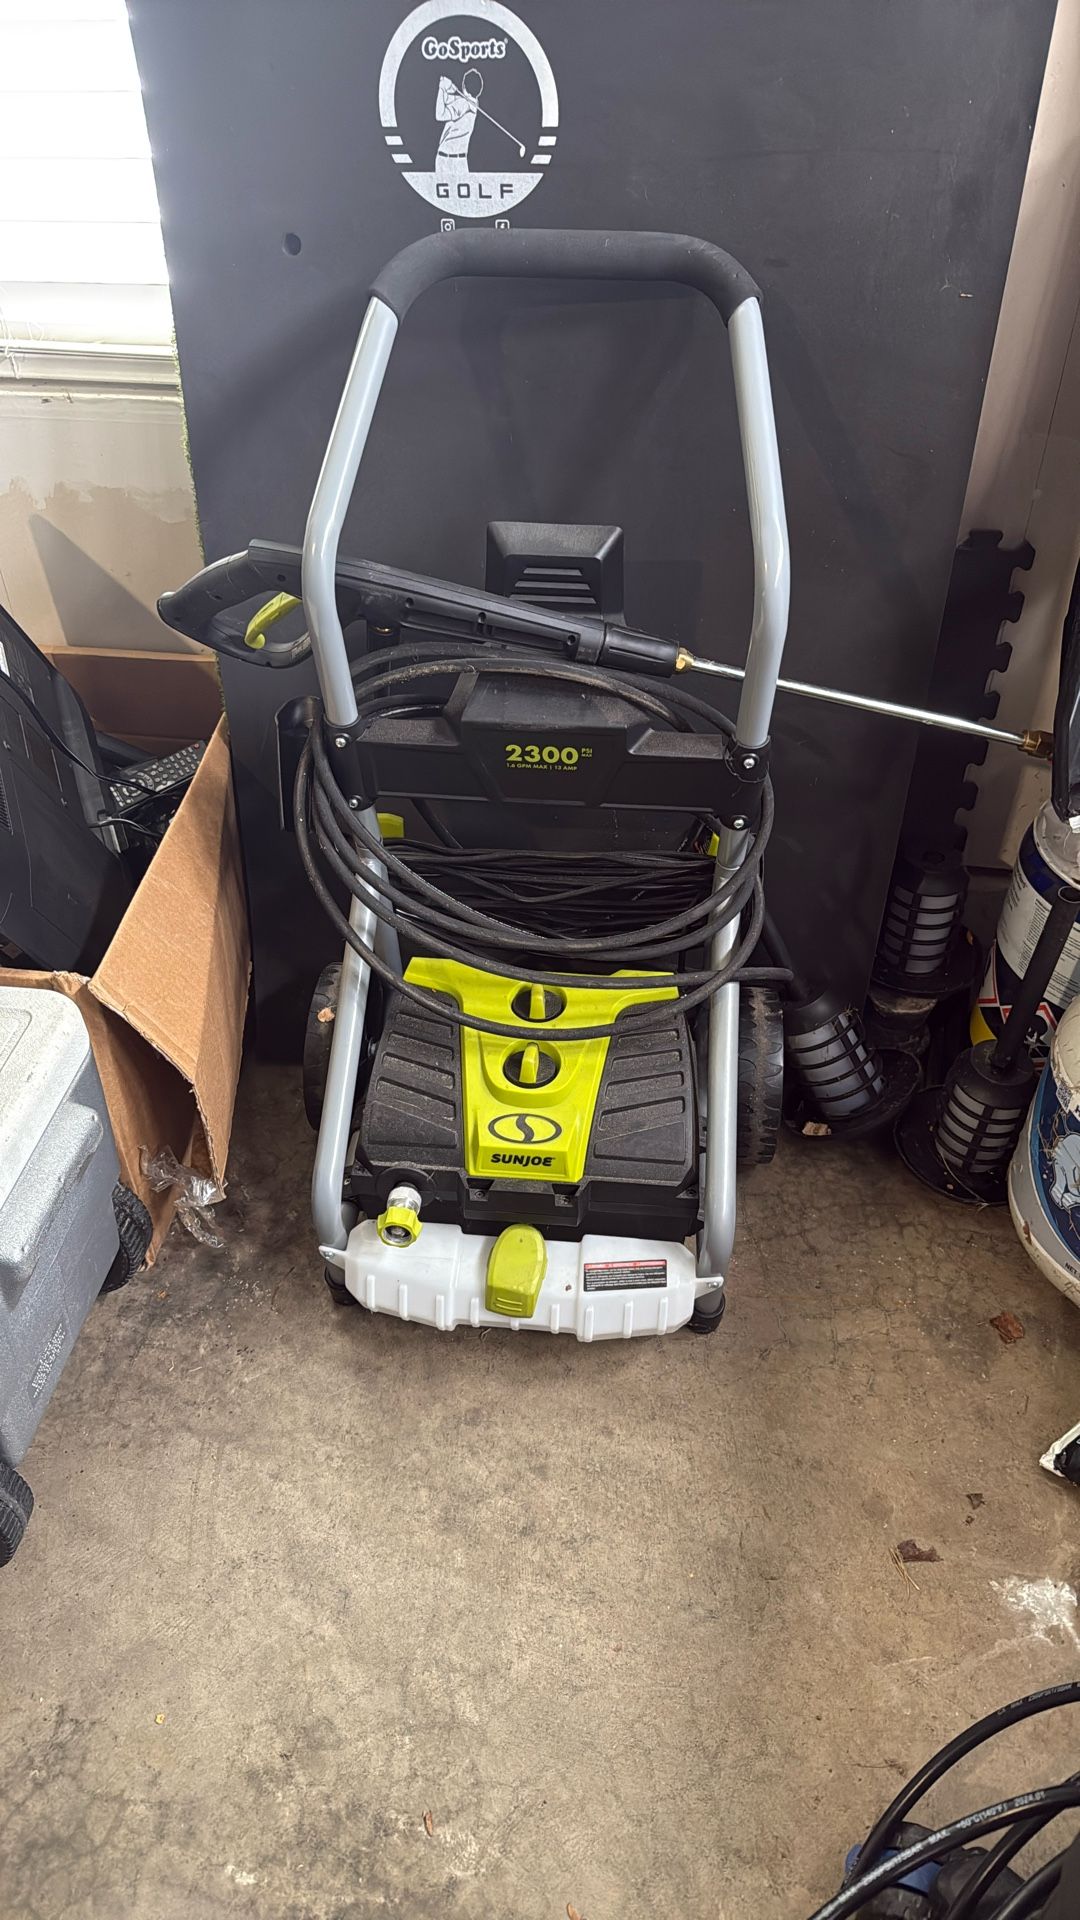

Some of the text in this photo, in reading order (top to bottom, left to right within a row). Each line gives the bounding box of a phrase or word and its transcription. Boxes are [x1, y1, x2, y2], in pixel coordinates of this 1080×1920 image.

[421, 36, 507, 63] GoSports
[436, 183, 513, 199] GOLF
[505, 744, 579, 764] 2300
[490, 1153, 553, 1167] SUNJOE
[1065, 1262, 1078, 1274] NET
